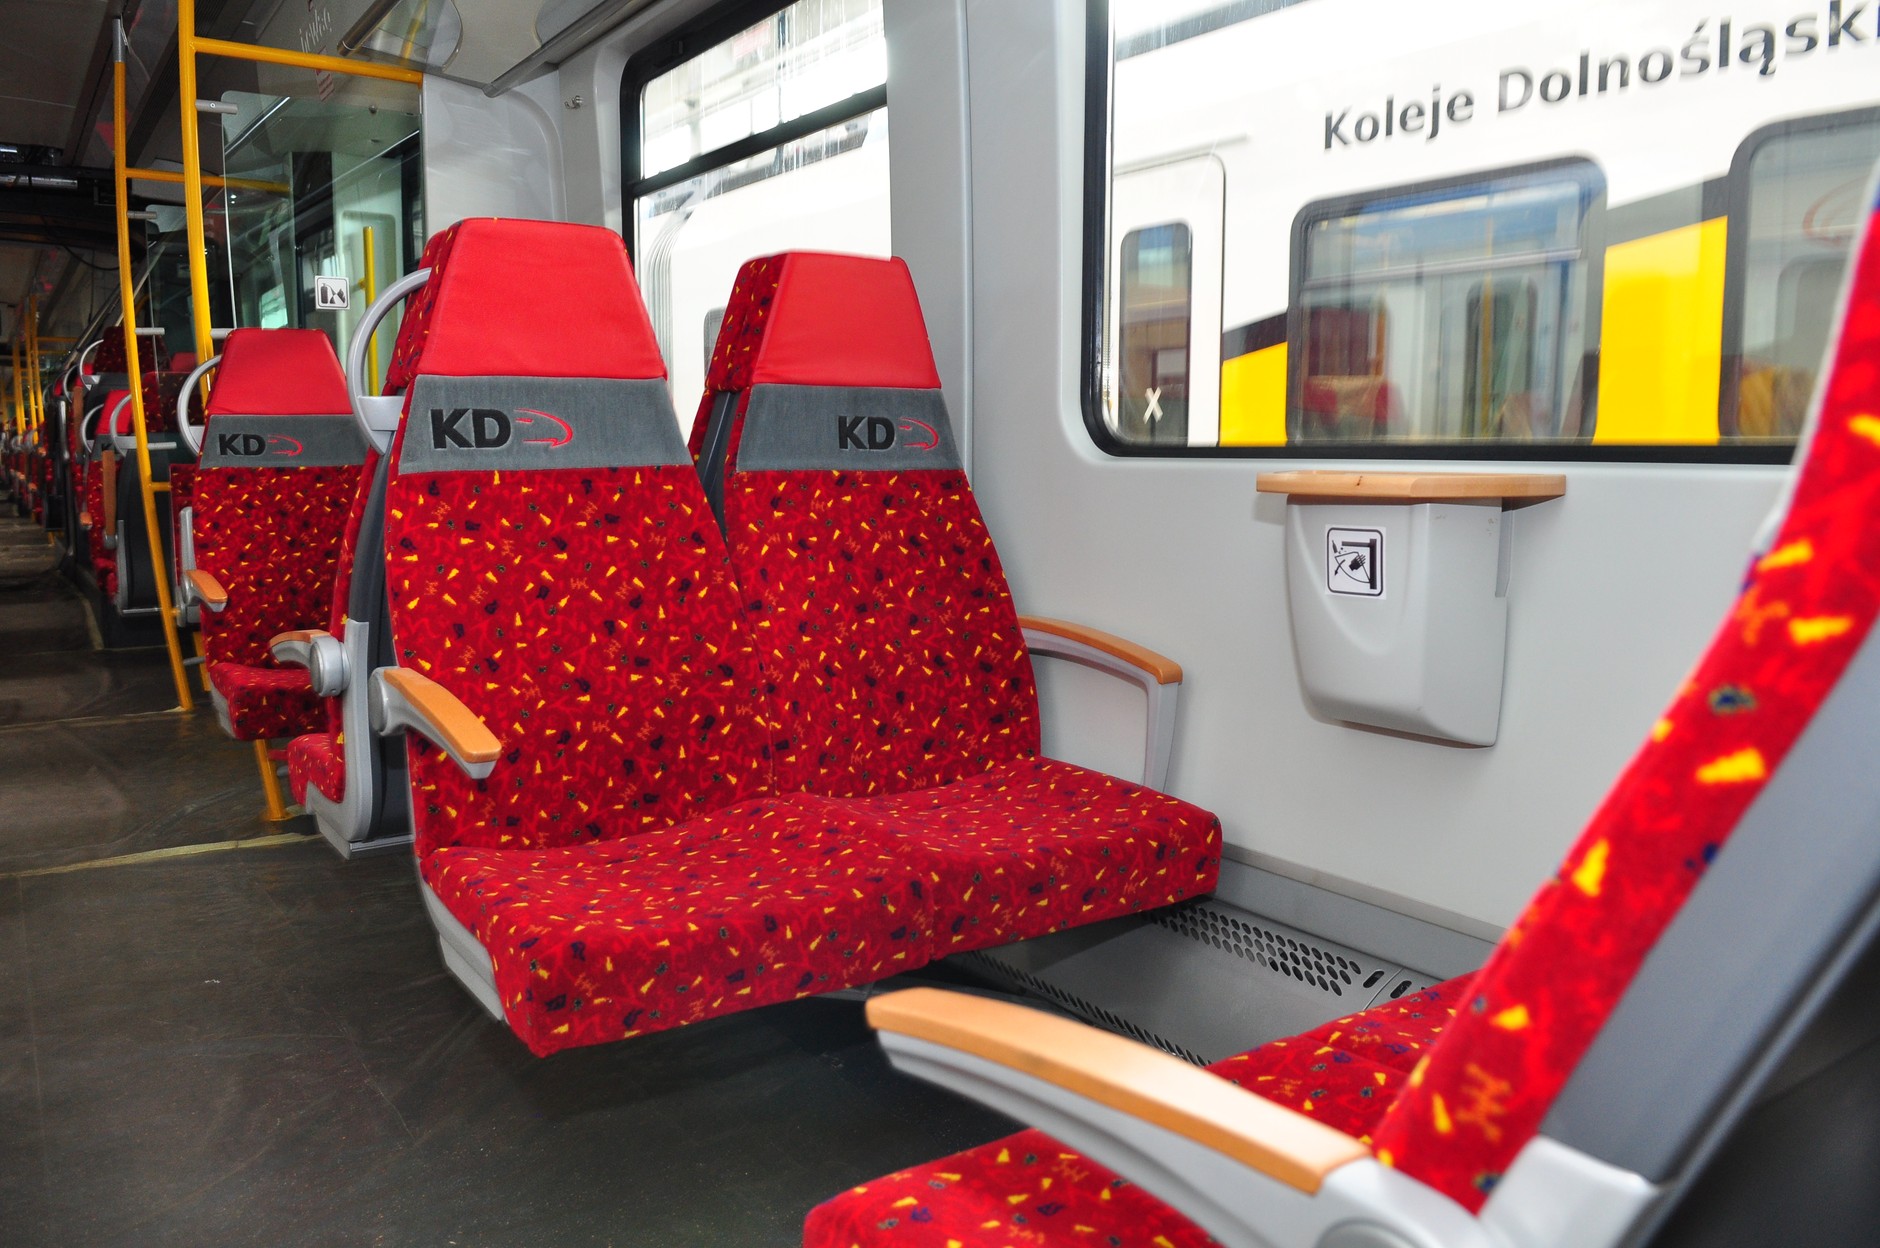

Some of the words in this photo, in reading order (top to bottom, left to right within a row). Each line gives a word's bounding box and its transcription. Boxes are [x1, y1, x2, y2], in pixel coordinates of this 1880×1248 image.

[1324, 84, 1474, 150] Koleje
[1498, 0, 1880, 112] Dolnośląsk
[219, 434, 266, 456] KD
[430, 408, 511, 449] KD
[838, 416, 895, 450] KD
